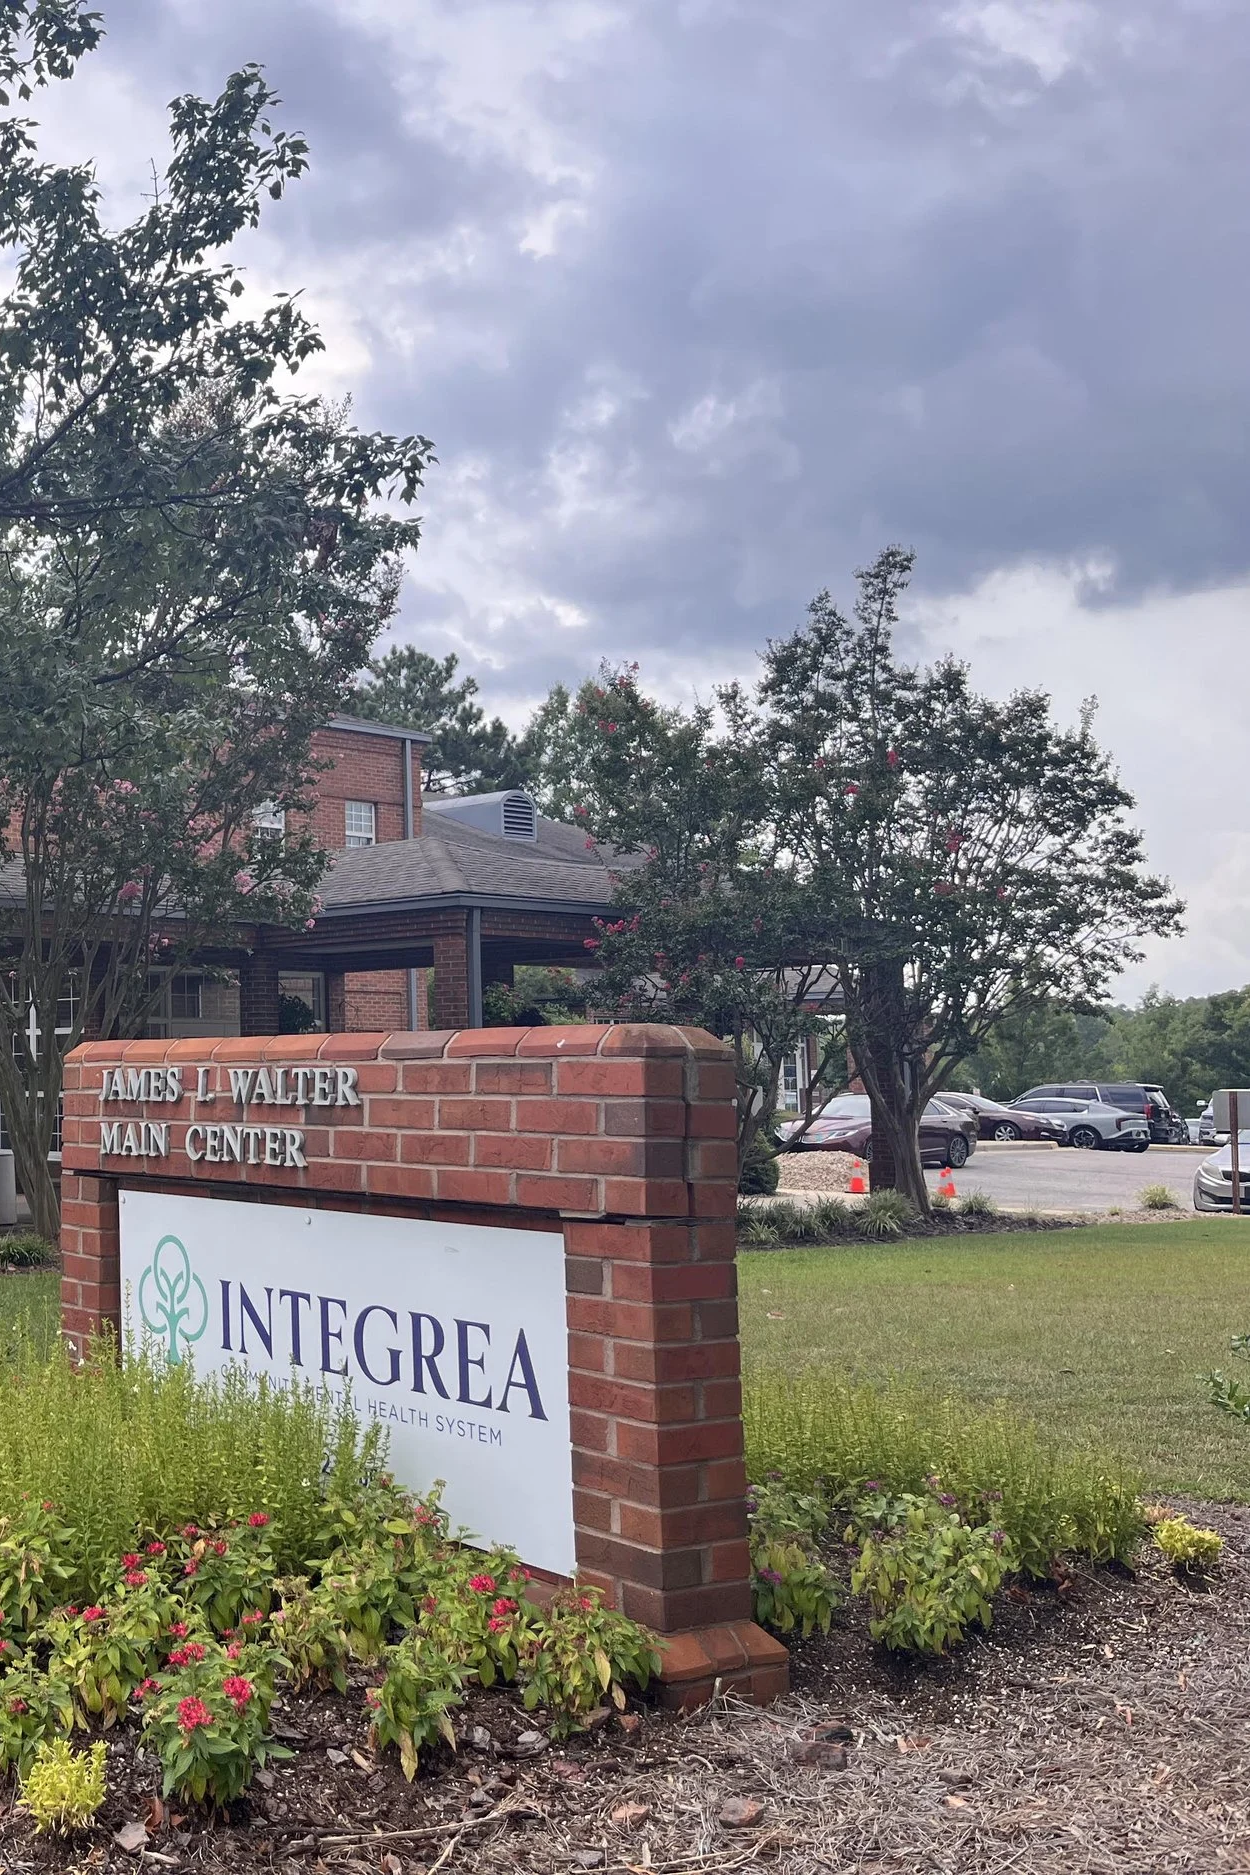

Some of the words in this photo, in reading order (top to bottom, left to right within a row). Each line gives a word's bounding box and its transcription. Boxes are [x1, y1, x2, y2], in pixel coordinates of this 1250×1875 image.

[99, 1067, 184, 1103] JAMES
[227, 1067, 362, 1106] WALTER
[100, 1122, 170, 1157] MAIN
[185, 1125, 309, 1168] CENTER
[219, 1279, 550, 1422] INTEGREA
[367, 1398, 428, 1428] HEALTH
[435, 1415, 503, 1447] SYSTEM
